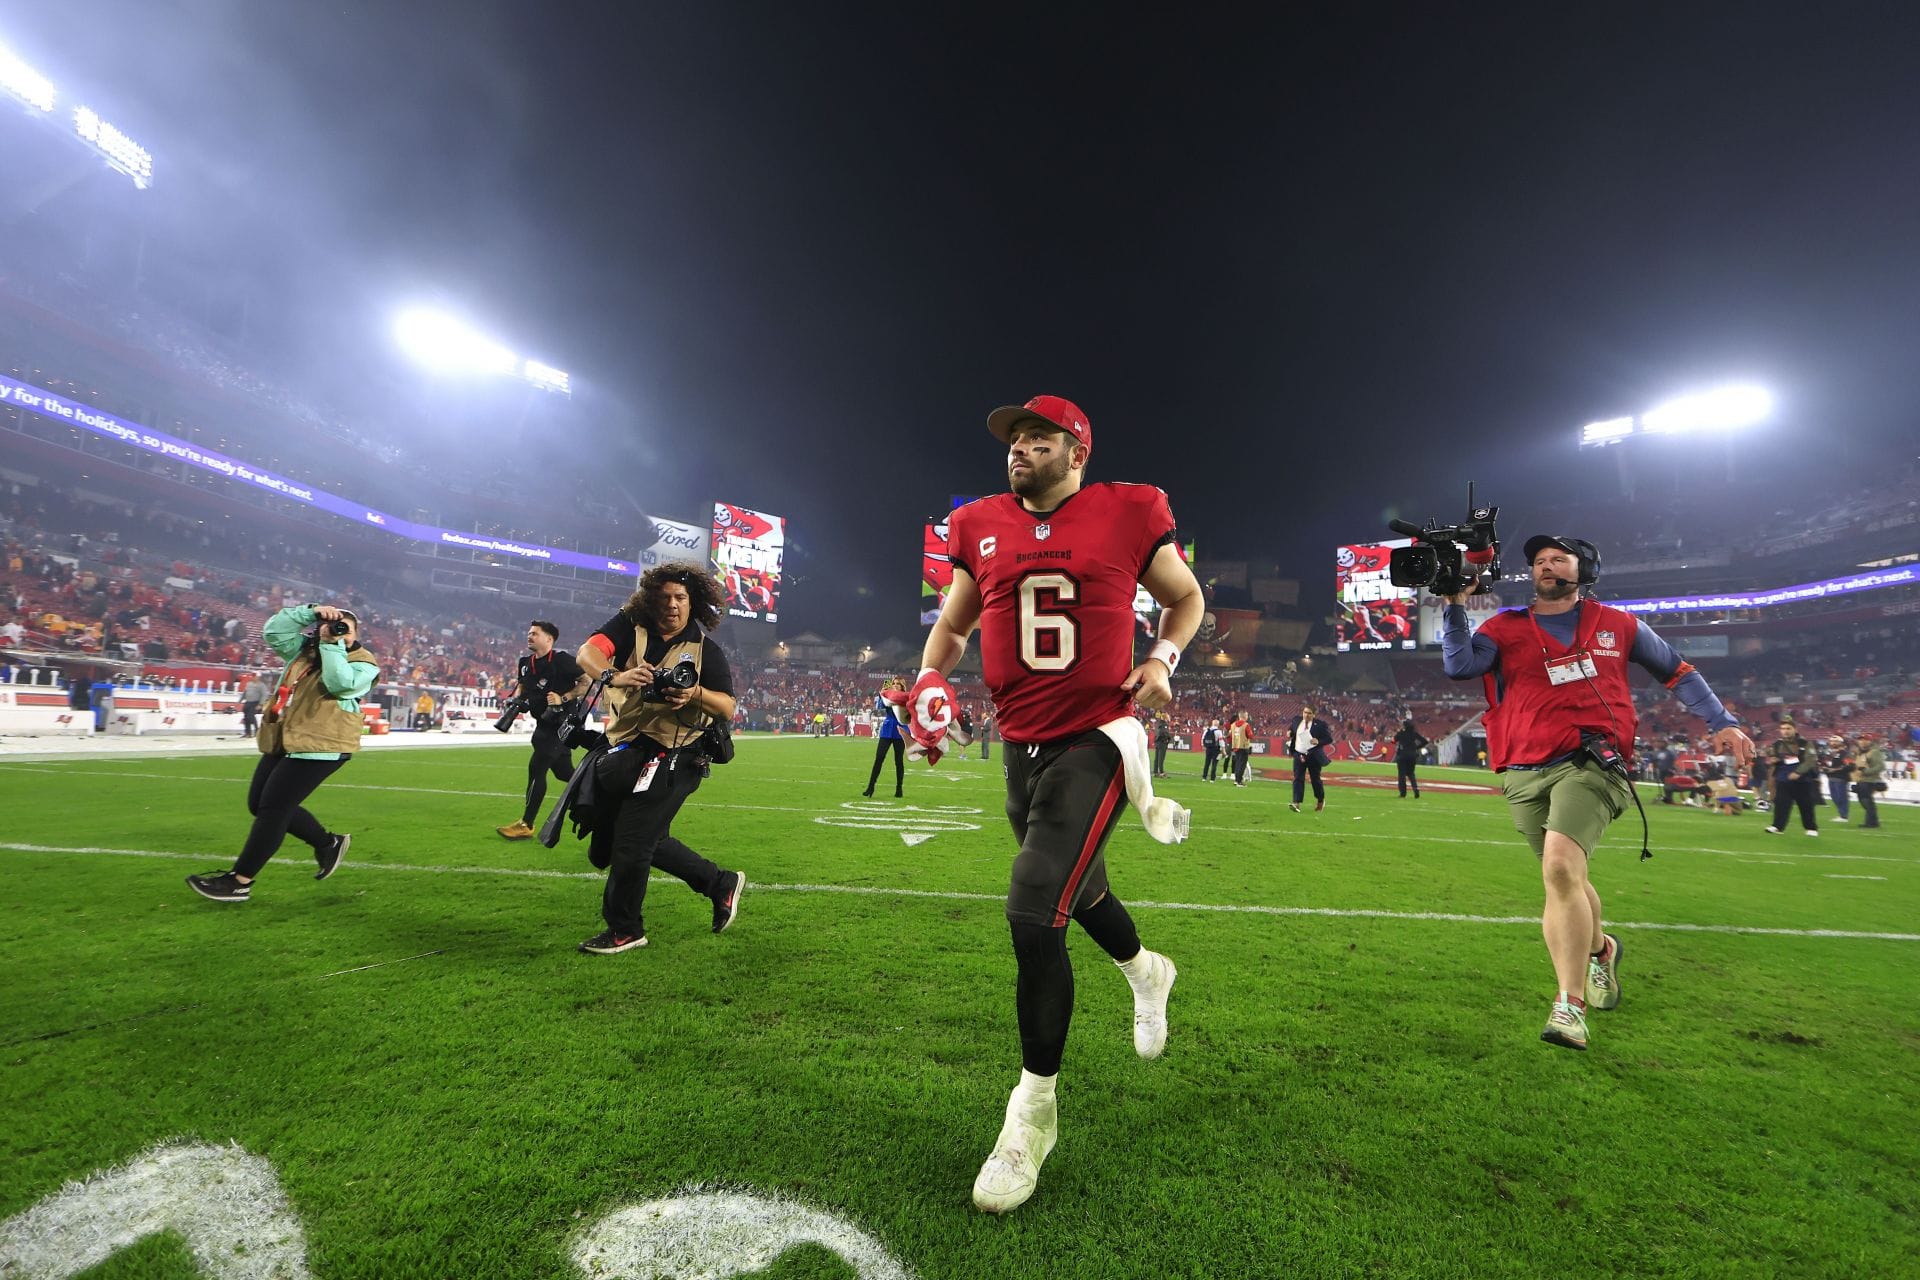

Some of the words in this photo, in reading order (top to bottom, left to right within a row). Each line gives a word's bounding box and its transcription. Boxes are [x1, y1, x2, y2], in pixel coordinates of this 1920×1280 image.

[14, 388, 42, 406] for
[44, 398, 73, 418] the
[75, 409, 141, 443] holidays,
[142, 435, 160, 448] so
[160, 441, 201, 462] you're
[202, 456, 236, 476] ready
[236, 466, 254, 480] for
[255, 475, 289, 492] what's
[656, 523, 700, 549] Ford
[979, 536, 996, 557] C
[1627, 602, 1658, 612] ready
[1659, 600, 1677, 610] for
[1677, 599, 1698, 608] the
[1754, 596, 1766, 604] so
[1826, 583, 1845, 593] for
[1014, 568, 1081, 676] 6
[915, 686, 952, 732] G
